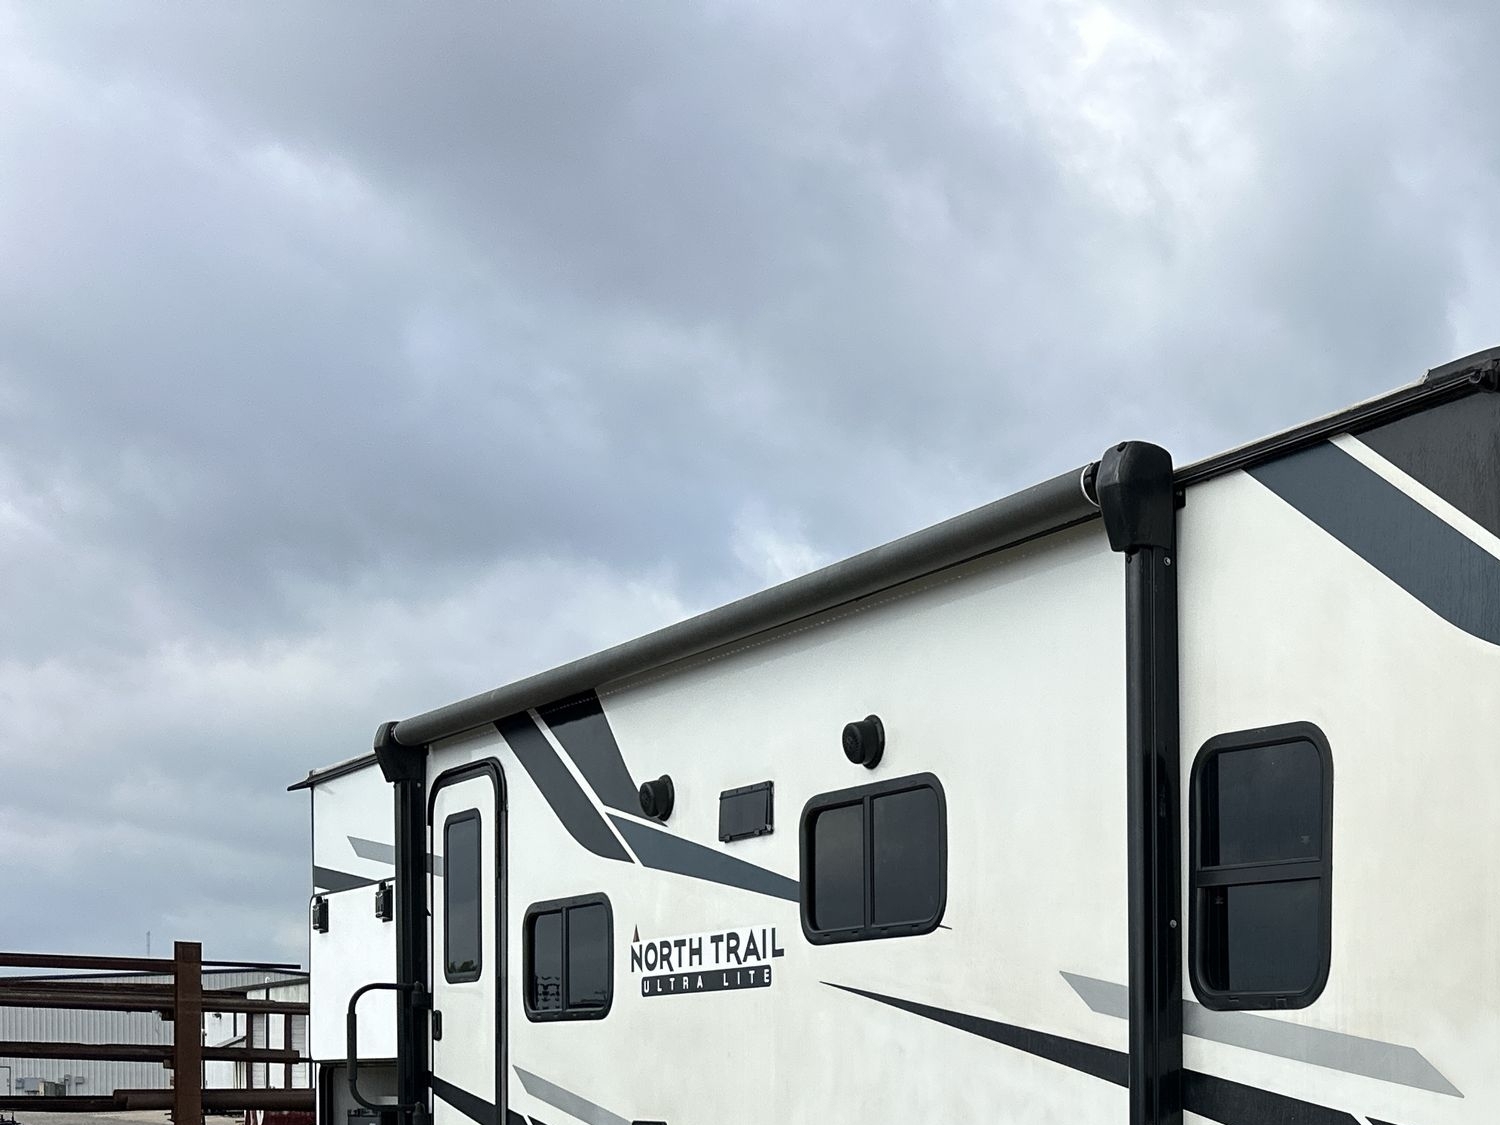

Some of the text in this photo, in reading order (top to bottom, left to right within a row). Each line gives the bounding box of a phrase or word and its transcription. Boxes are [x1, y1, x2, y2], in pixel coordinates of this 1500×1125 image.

[631, 927, 784, 972] NORTH TRAIL
[643, 969, 770, 993] ULTRA LITE
